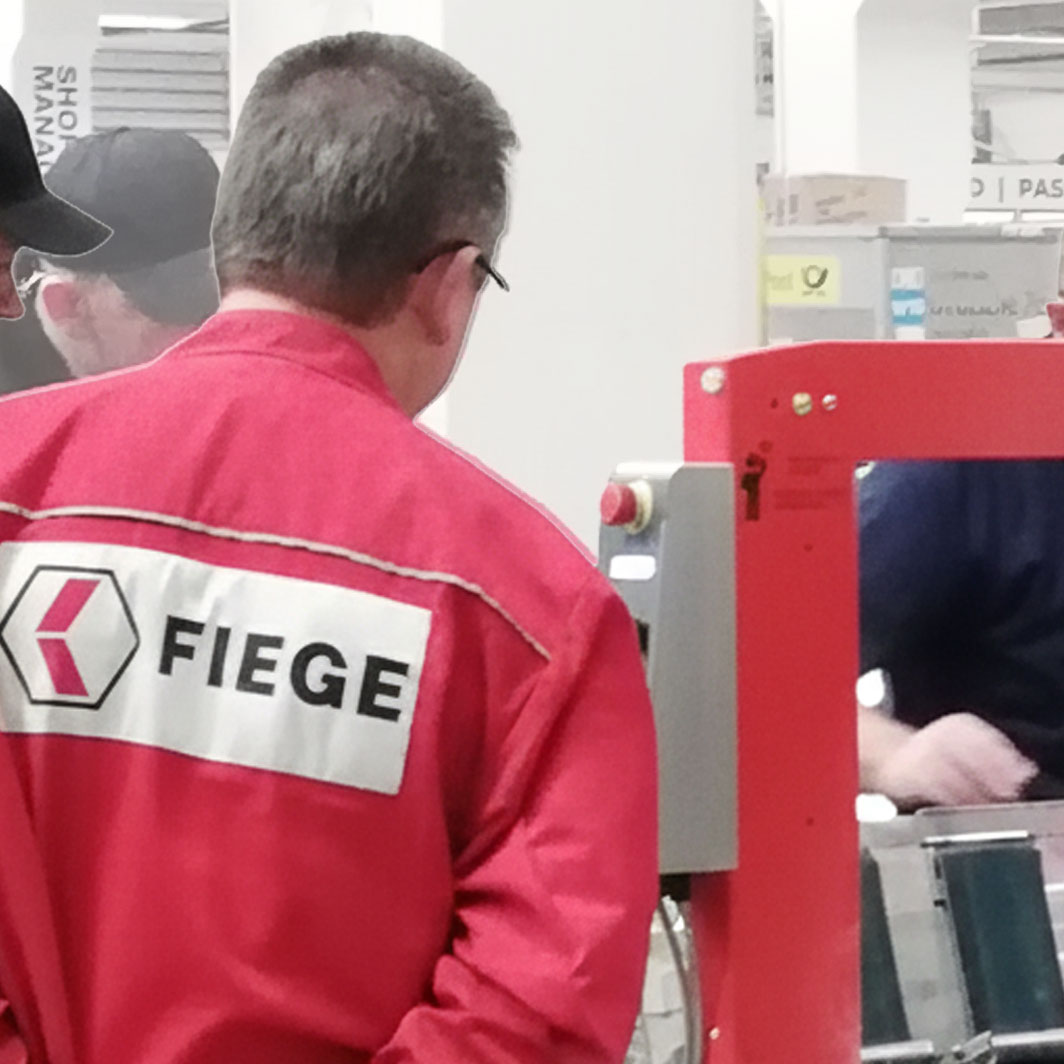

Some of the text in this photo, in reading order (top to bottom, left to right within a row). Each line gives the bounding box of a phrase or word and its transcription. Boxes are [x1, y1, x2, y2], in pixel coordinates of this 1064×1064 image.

[33, 66, 55, 166] MANA
[56, 65, 78, 140] SHO
[158, 614, 410, 722] FIEGE
